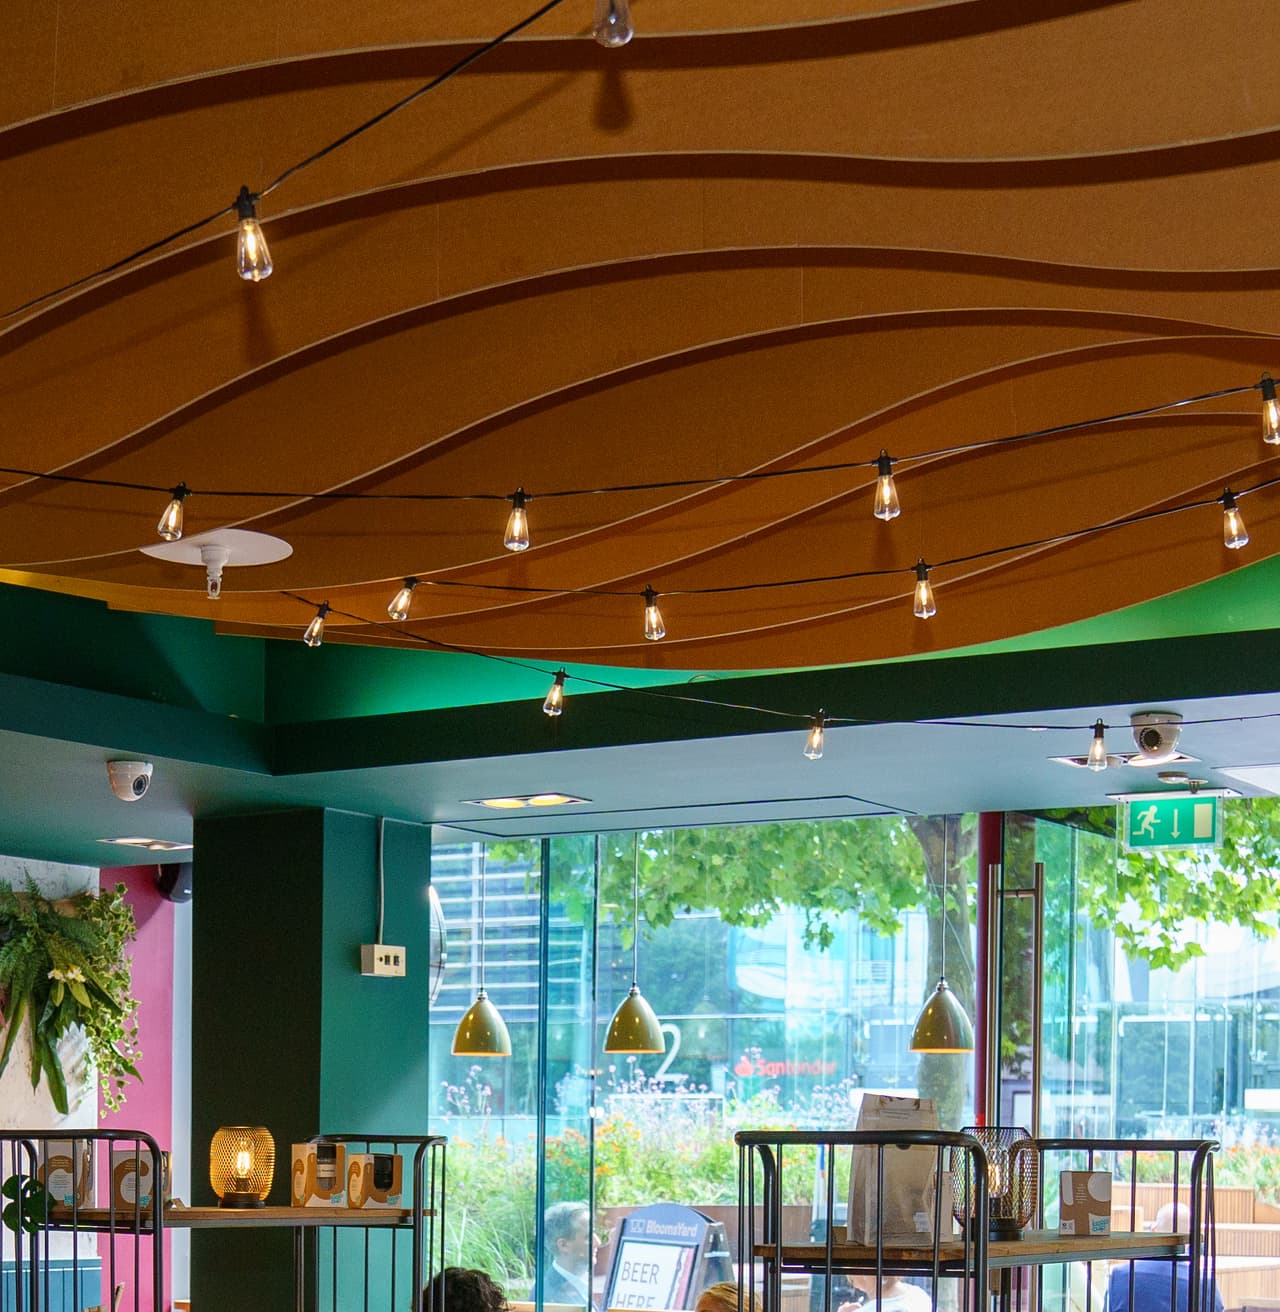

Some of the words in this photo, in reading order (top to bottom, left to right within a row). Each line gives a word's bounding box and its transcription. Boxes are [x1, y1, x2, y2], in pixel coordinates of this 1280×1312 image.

[755, 1058, 837, 1076] Santander
[646, 1219, 698, 1237] BloomsYard
[621, 1260, 661, 1285] BEER
